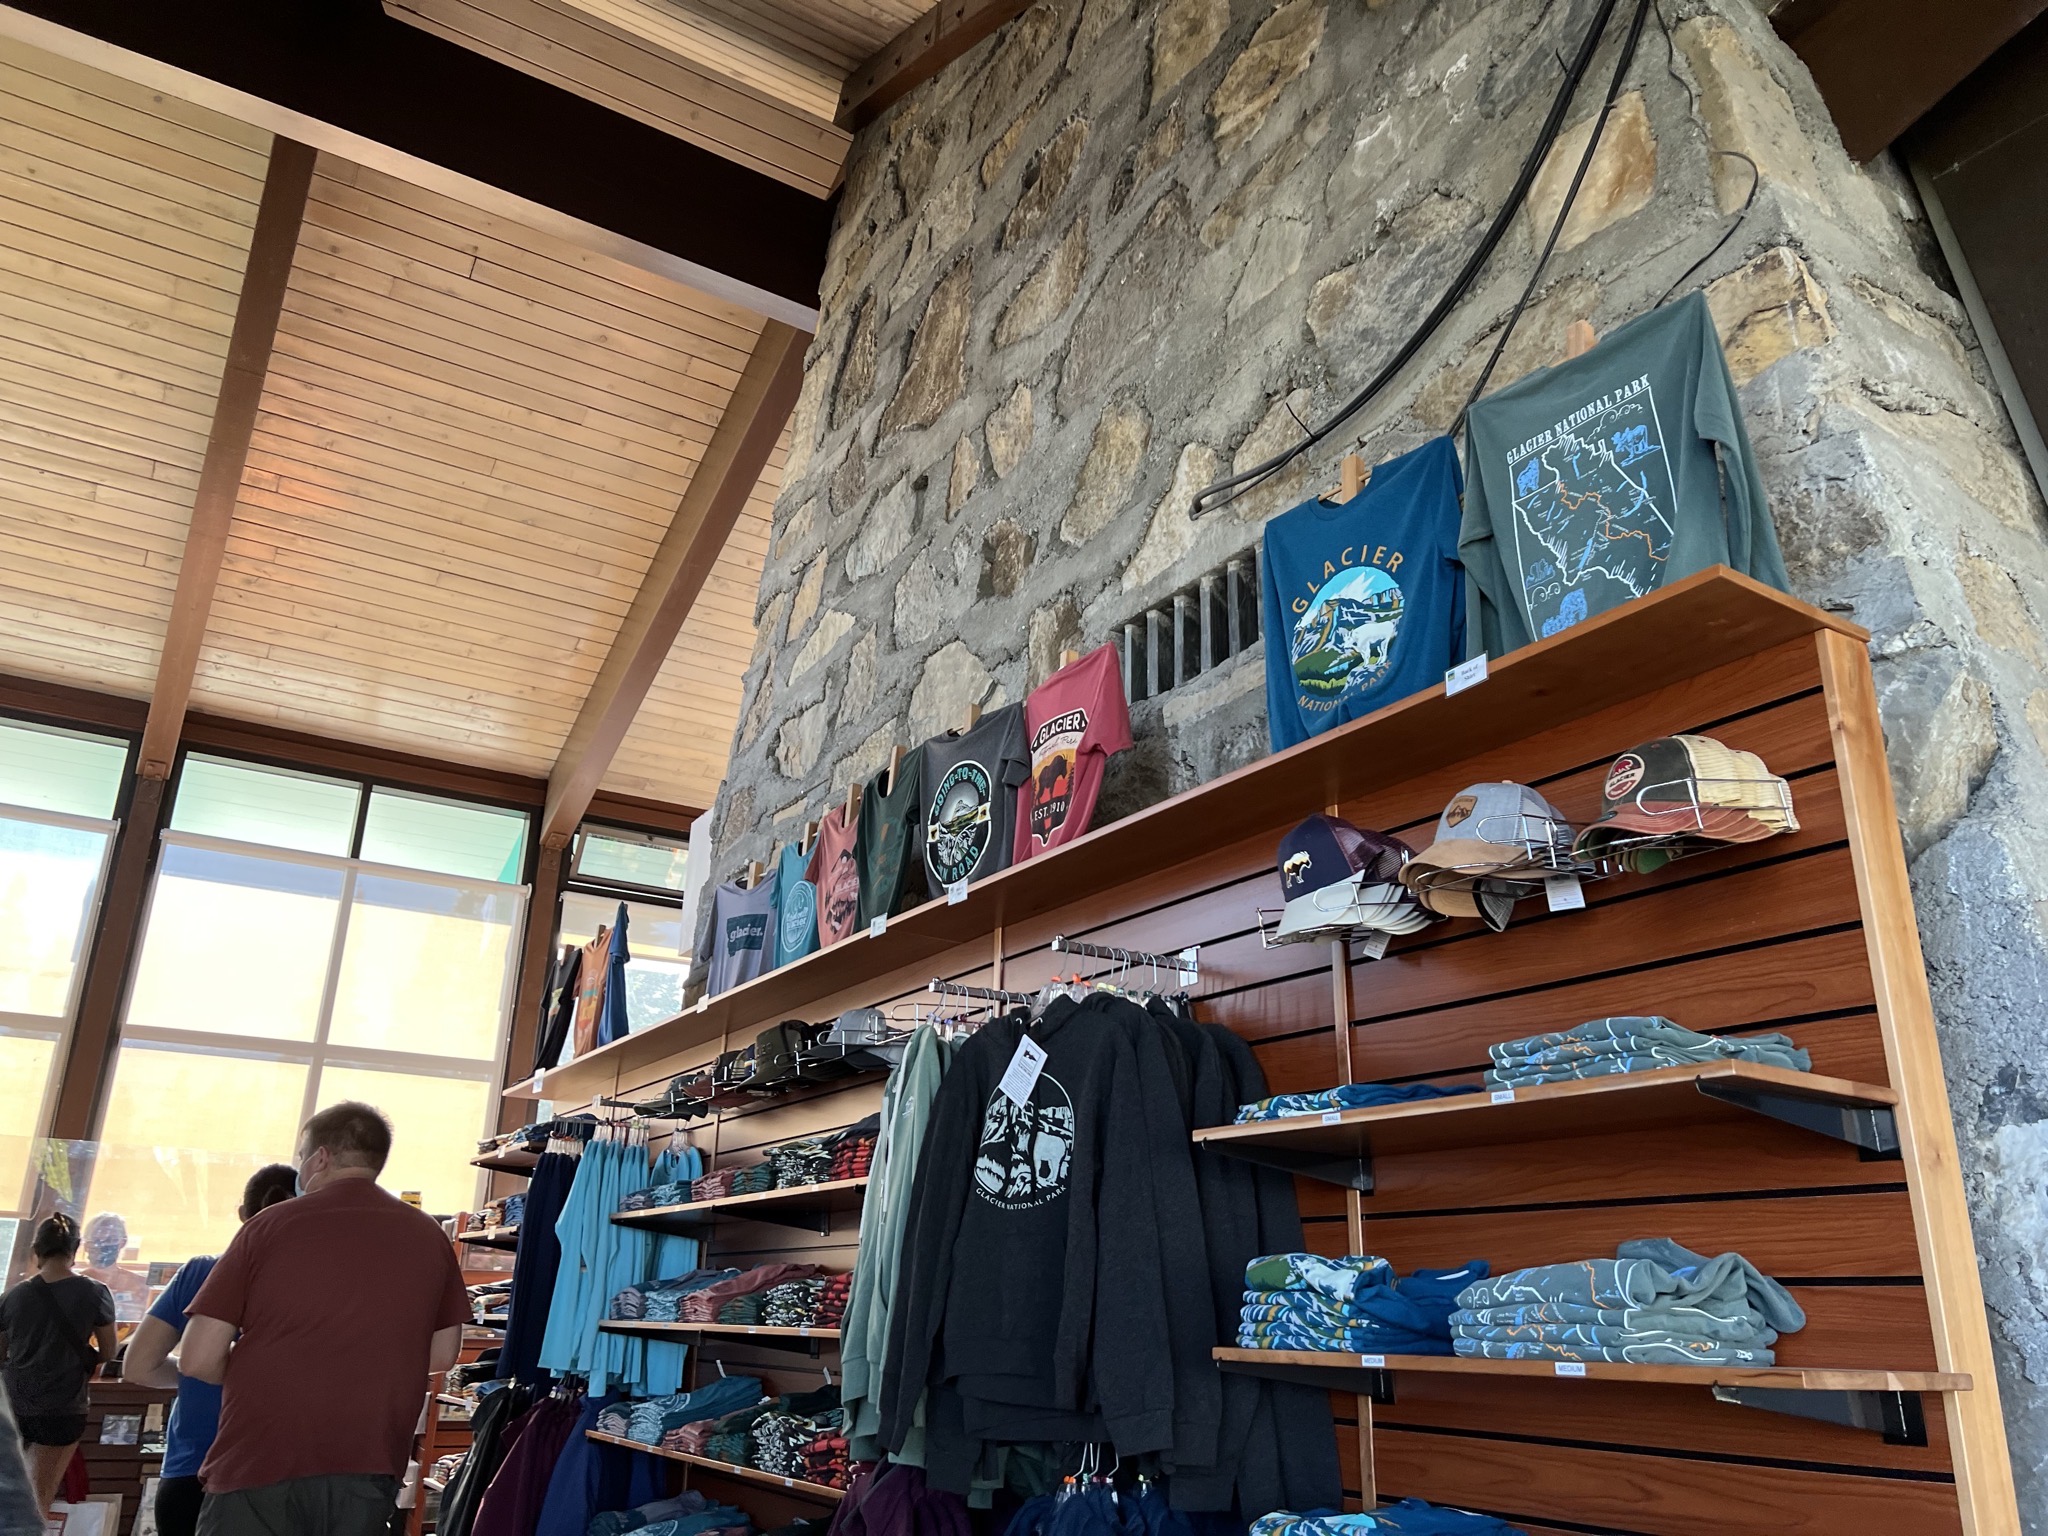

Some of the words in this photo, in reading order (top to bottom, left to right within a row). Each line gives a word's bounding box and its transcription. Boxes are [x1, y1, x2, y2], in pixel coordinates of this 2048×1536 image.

[1506, 429, 1553, 465] GLACIER
[1554, 394, 1613, 437] NATIONAL
[1614, 373, 1650, 402] PARK
[1291, 544, 1404, 614] GLACIER
[1039, 713, 1081, 744] GLACIER
[1034, 806, 1049, 821] EST.
[1049, 801, 1065, 814] 1910
[952, 845, 979, 880] ROAD
[975, 1187, 1005, 1209] GLACIER
[1045, 1184, 1067, 1201] PARK
[1558, 1364, 1583, 1373] MEDIUM
